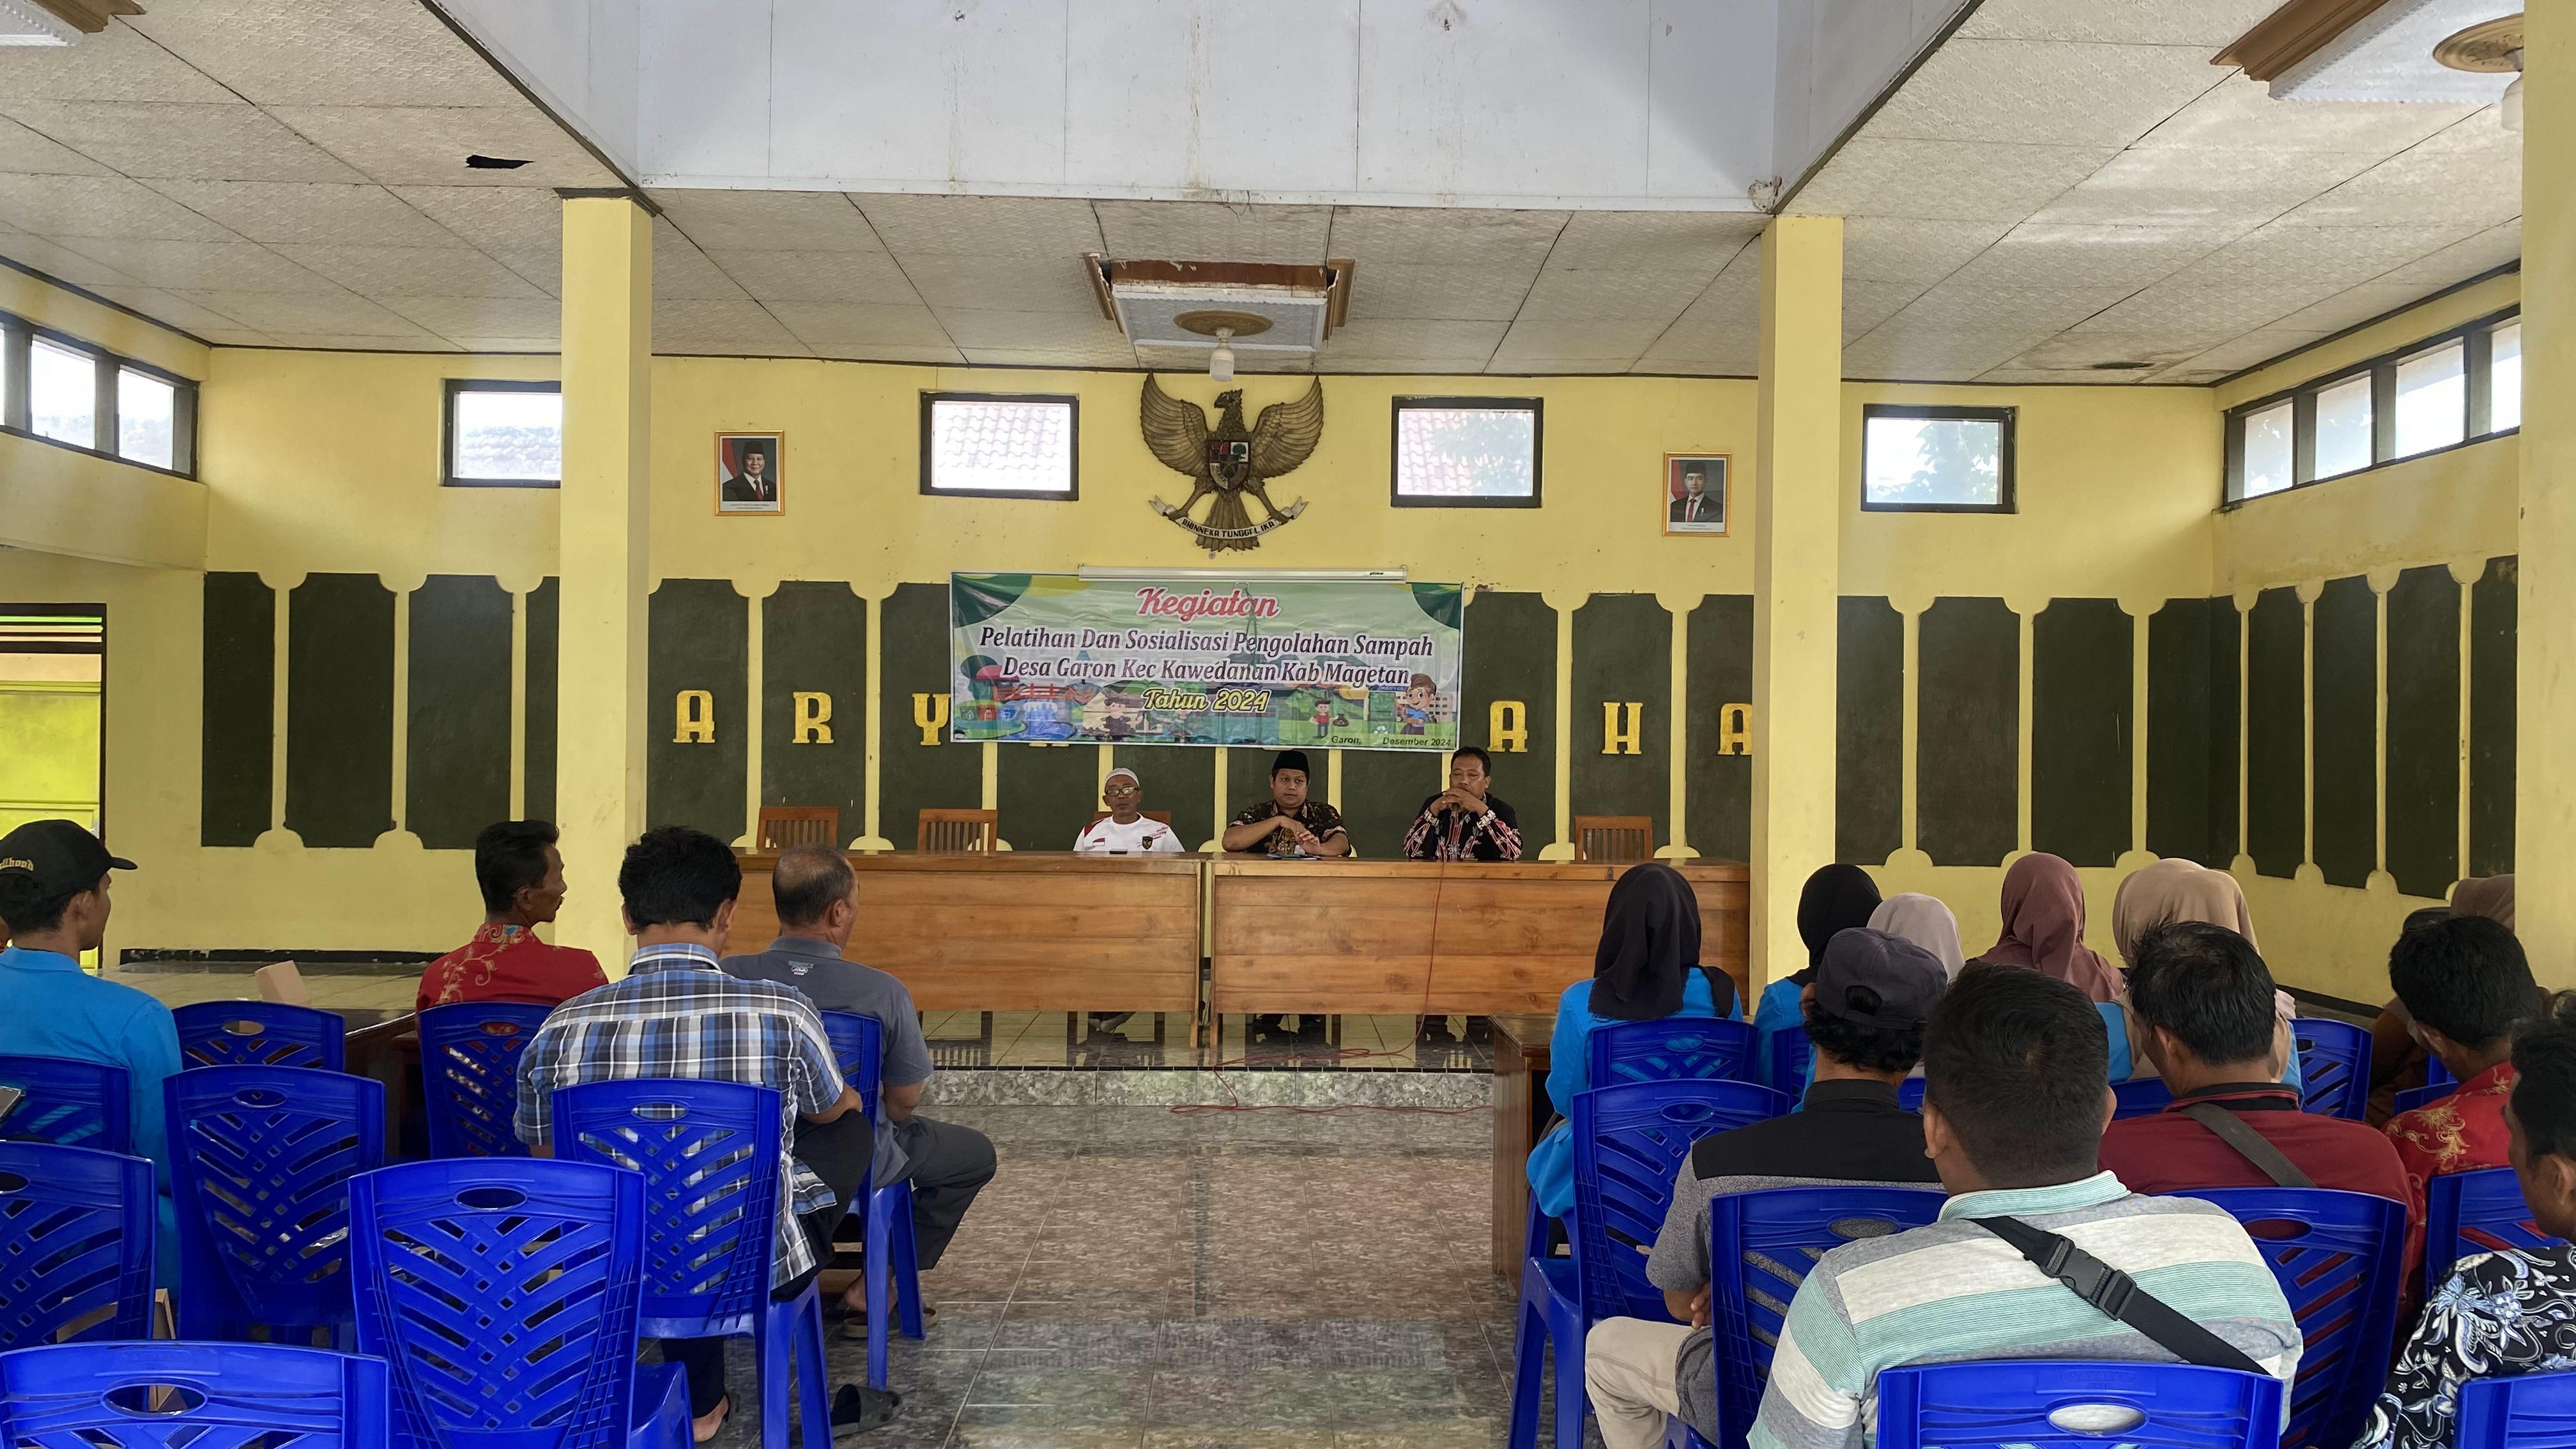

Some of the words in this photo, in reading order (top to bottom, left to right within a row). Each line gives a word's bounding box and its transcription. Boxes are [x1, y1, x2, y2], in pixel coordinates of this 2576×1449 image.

[1182, 518, 1220, 537] BHINNEKA
[1261, 521, 1275, 532] IKA
[1138, 588, 1280, 621] Kegiatan
[980, 627, 1076, 648] Pelatihan
[1081, 629, 1120, 649] Dan
[1126, 630, 1228, 650] Sosialisasi
[1233, 631, 1349, 657] Pengolahan
[1354, 634, 1433, 661] Sampah
[1003, 657, 1050, 676] Desa
[1057, 658, 1116, 678] Garon
[1121, 659, 1156, 678] Kec
[1162, 660, 1276, 682] Kawedanan
[1281, 663, 1320, 682] Kab
[1324, 663, 1409, 688] Magetan
[1144, 690, 1209, 710] Tahun
[1215, 691, 1270, 712] 2024
[1331, 736, 1361, 745] Garon,
[1383, 737, 1427, 746] Desember
